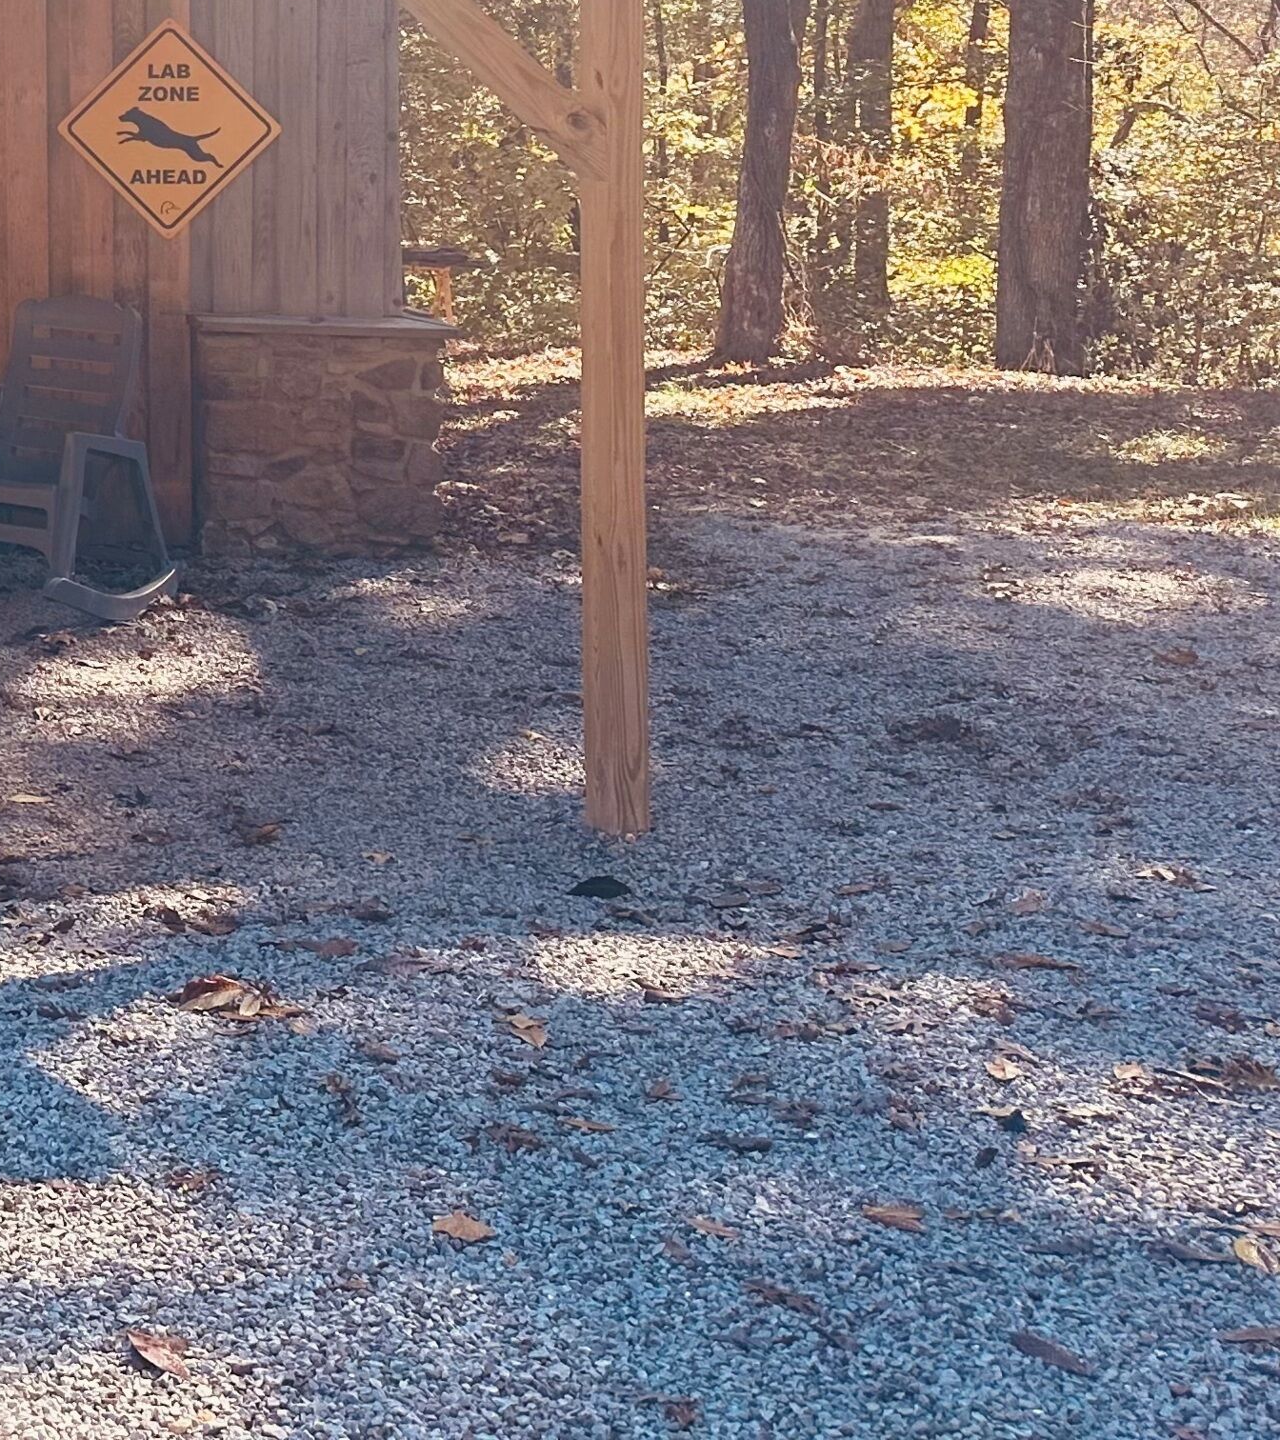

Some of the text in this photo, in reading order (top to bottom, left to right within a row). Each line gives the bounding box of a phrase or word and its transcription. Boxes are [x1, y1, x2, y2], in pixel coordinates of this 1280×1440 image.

[148, 64, 190, 79] LAB
[138, 86, 200, 102] ZONE
[130, 169, 207, 185] AHEAD
